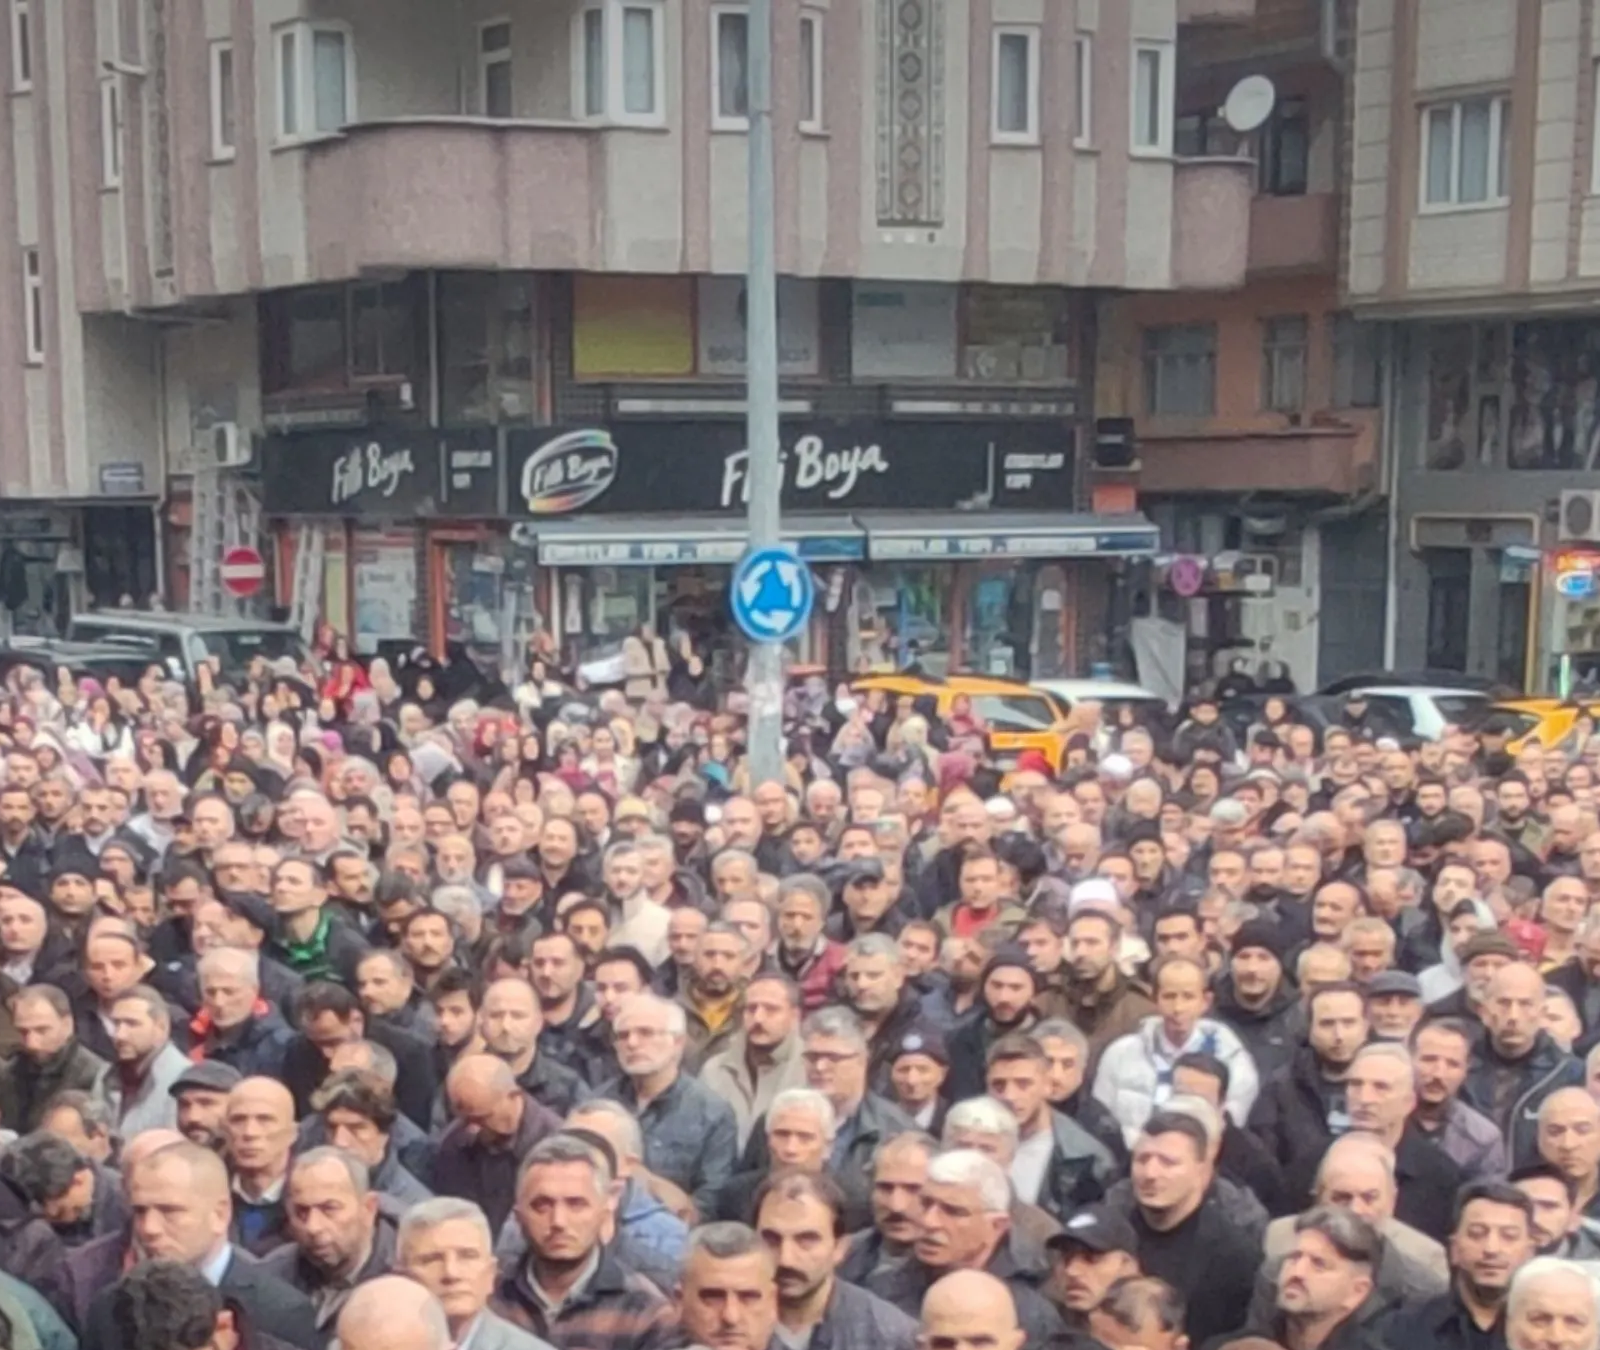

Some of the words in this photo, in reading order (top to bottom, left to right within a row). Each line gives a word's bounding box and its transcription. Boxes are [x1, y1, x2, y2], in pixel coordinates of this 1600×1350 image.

[367, 442, 414, 498] Boya
[566, 453, 612, 485] Boya
[794, 434, 890, 499] Boya
